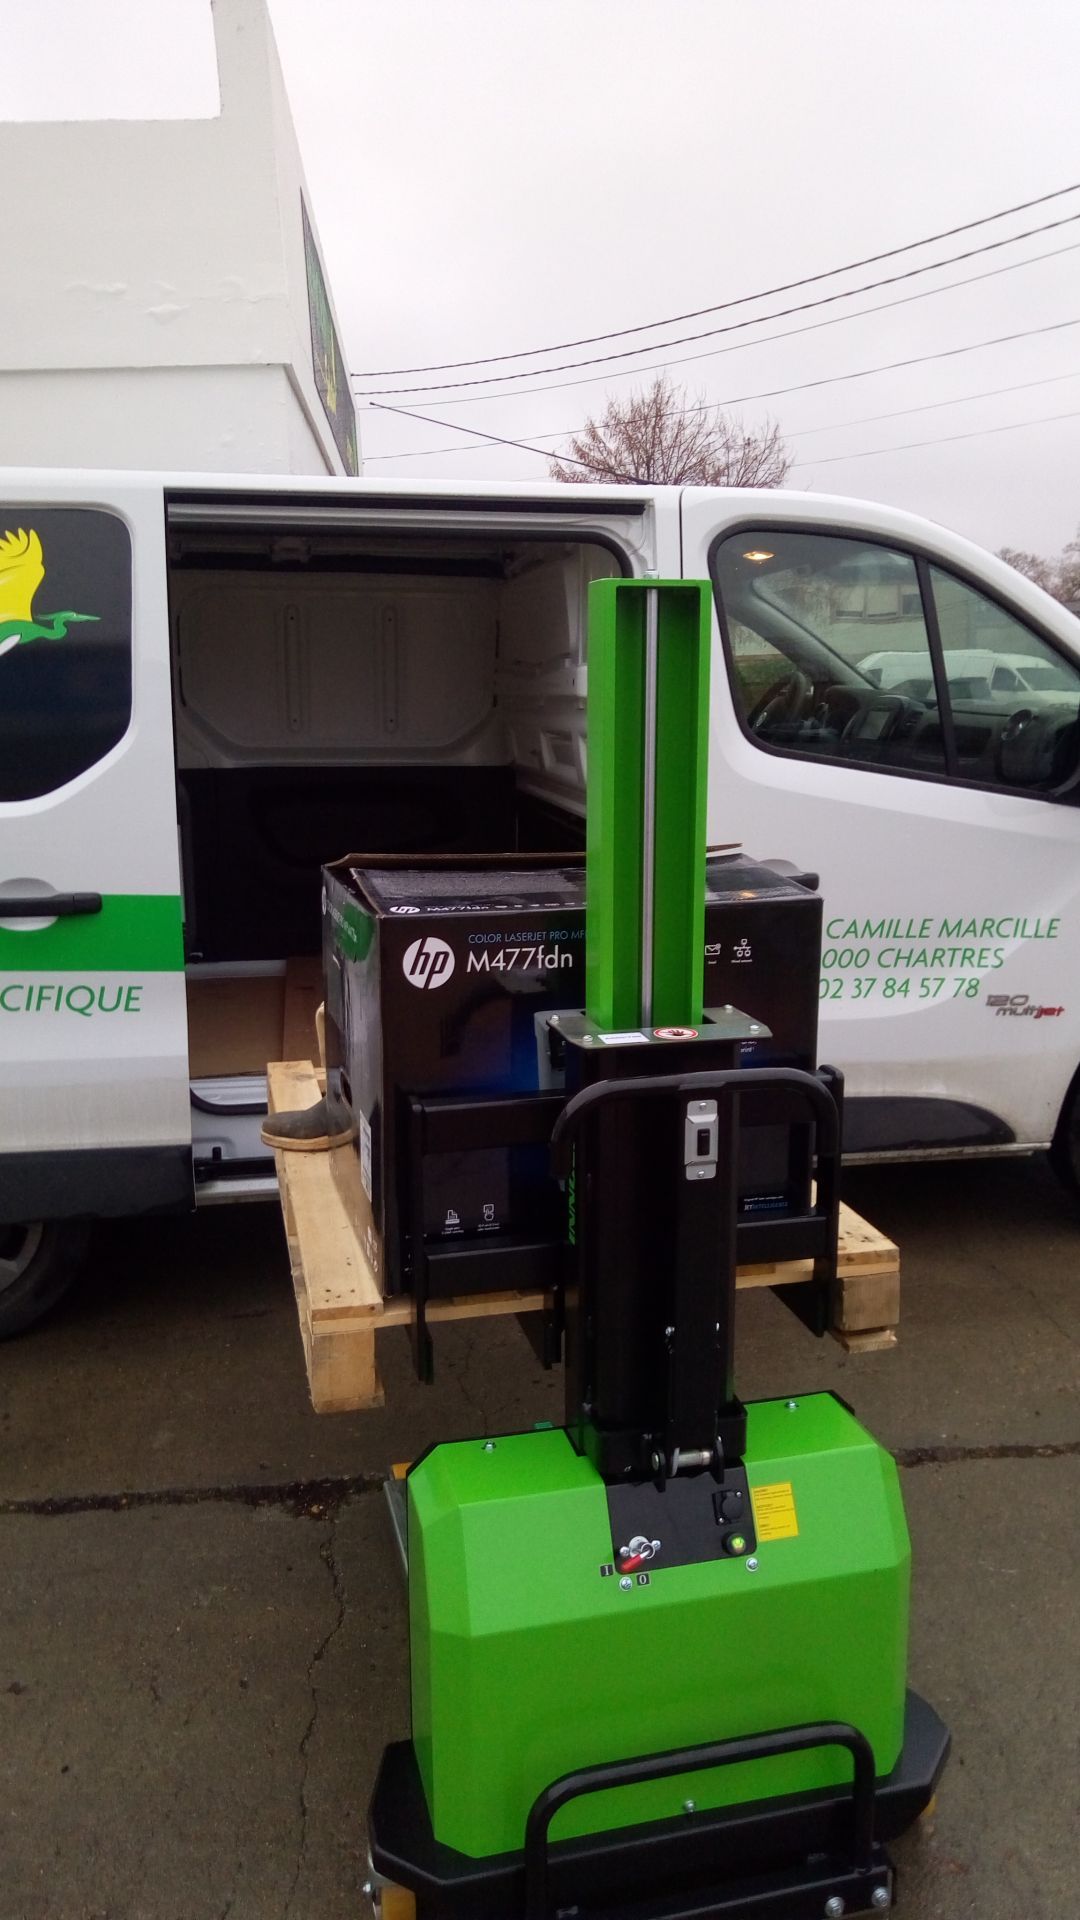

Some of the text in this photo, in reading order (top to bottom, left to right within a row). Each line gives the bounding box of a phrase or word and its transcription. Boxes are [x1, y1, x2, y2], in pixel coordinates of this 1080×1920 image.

[468, 930, 585, 944] COLOR LASERJET PRO MF
[826, 917, 1061, 940] CAMILLE MARCILLE
[402, 936, 456, 990] hp
[466, 945, 573, 973] M477fdn
[877, 948, 1005, 969] CHARTRES
[851, 978, 877, 998] 37
[882, 978, 910, 998] 84
[918, 978, 946, 998] 57
[952, 978, 981, 998] 78
